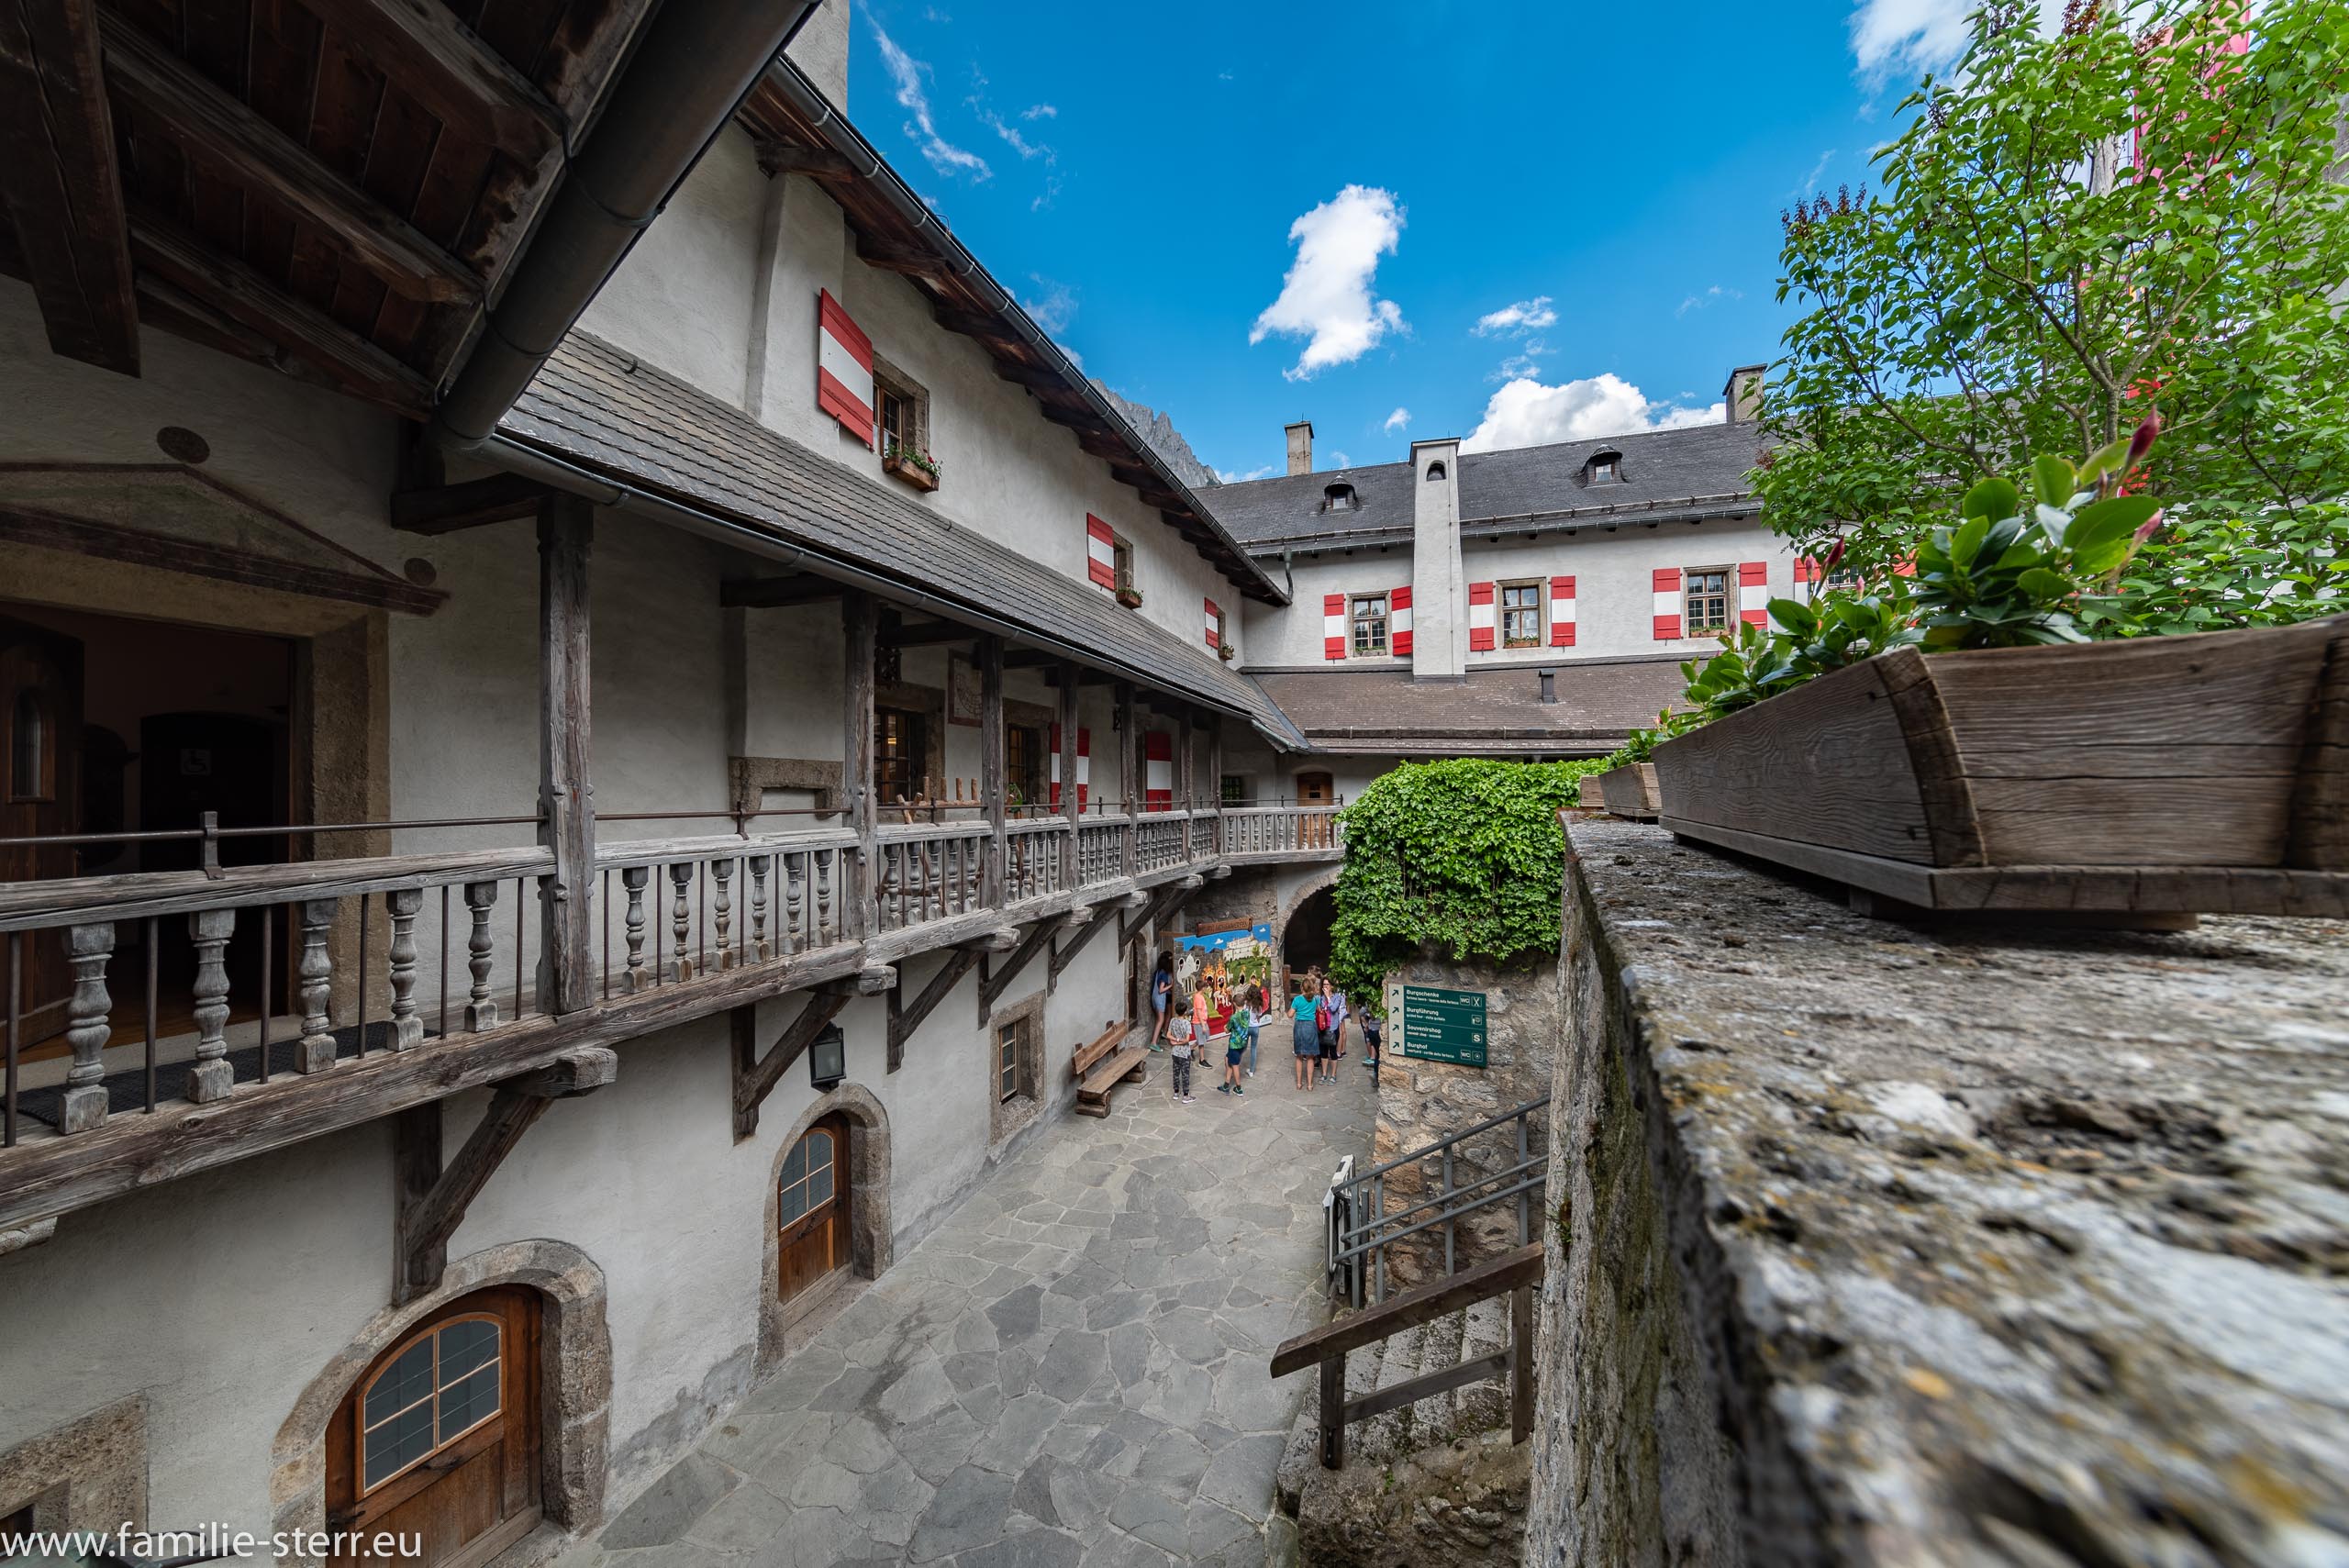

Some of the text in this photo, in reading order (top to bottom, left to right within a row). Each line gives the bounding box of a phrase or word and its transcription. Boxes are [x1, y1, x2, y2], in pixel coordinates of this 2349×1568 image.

[1407, 989, 1440, 998] Burgschenke
[1407, 1006, 1439, 1017] Burgführung
[1407, 1024, 1442, 1034] Souvenirshop
[1407, 1041, 1428, 1050] Burghof
